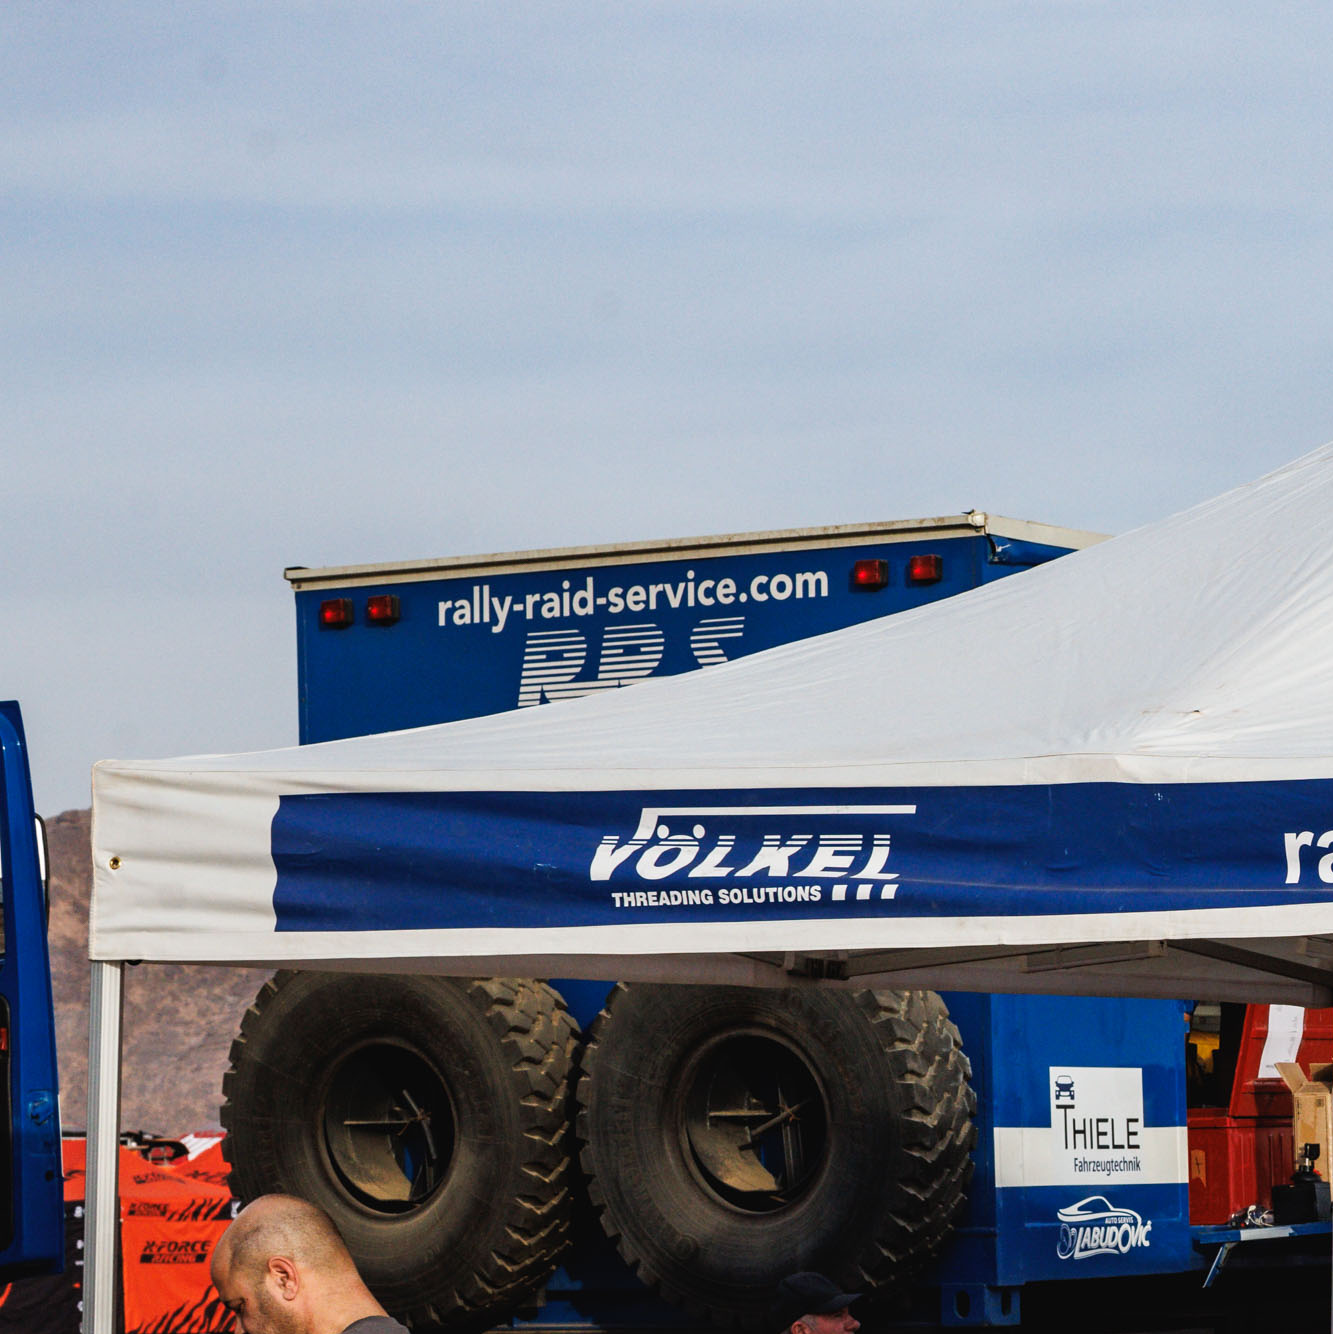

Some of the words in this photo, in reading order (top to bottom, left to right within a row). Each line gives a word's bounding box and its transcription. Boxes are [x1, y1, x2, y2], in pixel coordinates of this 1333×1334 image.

[437, 569, 829, 633] rally-raid-service.com
[590, 805, 916, 882] VÖLKEL
[611, 887, 714, 908] THREADING
[718, 884, 822, 905] SOLUTIONS
[1056, 1104, 1140, 1150] THIELE
[1073, 1156, 1141, 1176] Fahrzeugtechnik
